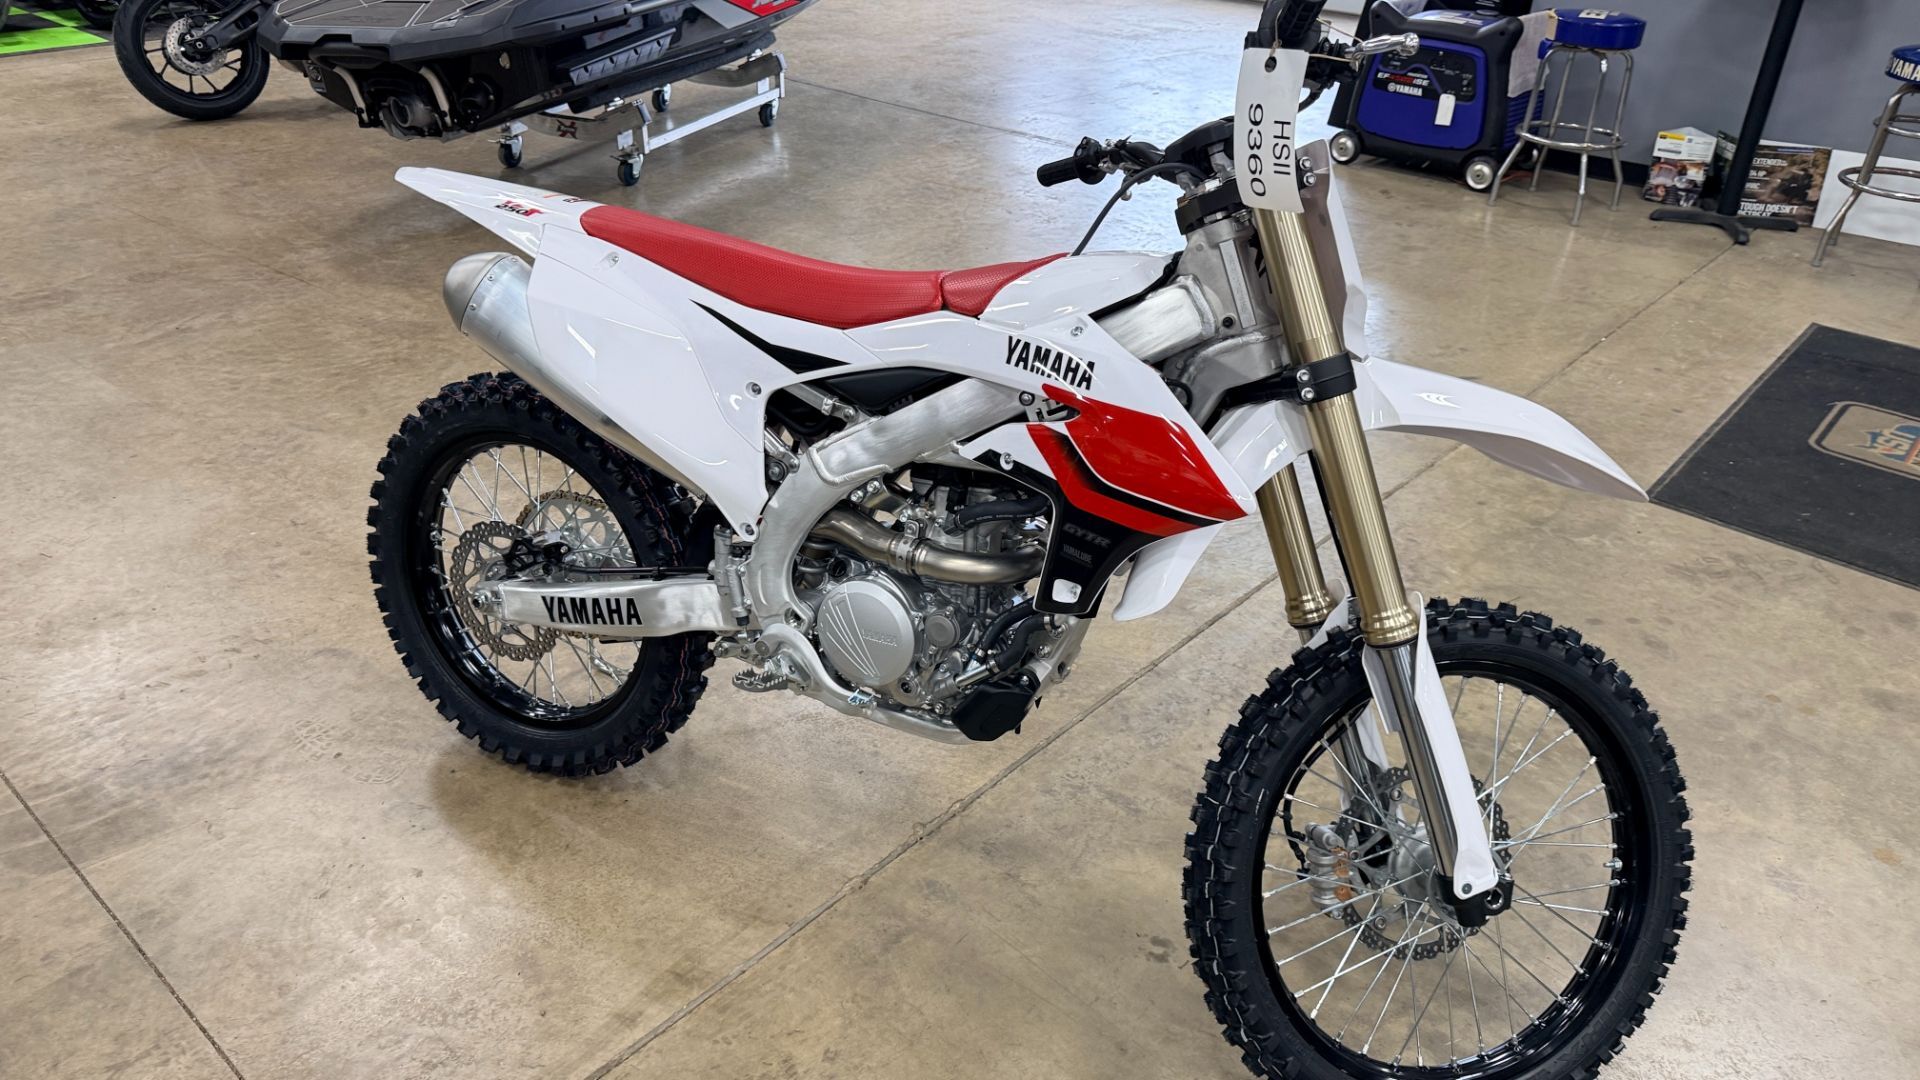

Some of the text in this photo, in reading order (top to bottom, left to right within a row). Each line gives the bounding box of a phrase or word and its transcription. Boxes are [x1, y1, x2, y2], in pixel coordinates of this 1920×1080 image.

[1395, 84, 1422, 96] YAMAHA
[1247, 103, 1267, 197] 9360
[1740, 202, 1765, 212] TOUGH
[1005, 335, 1096, 391] YAMAHA
[1062, 522, 1111, 549] GYTR
[540, 595, 643, 626] YAMAHA
